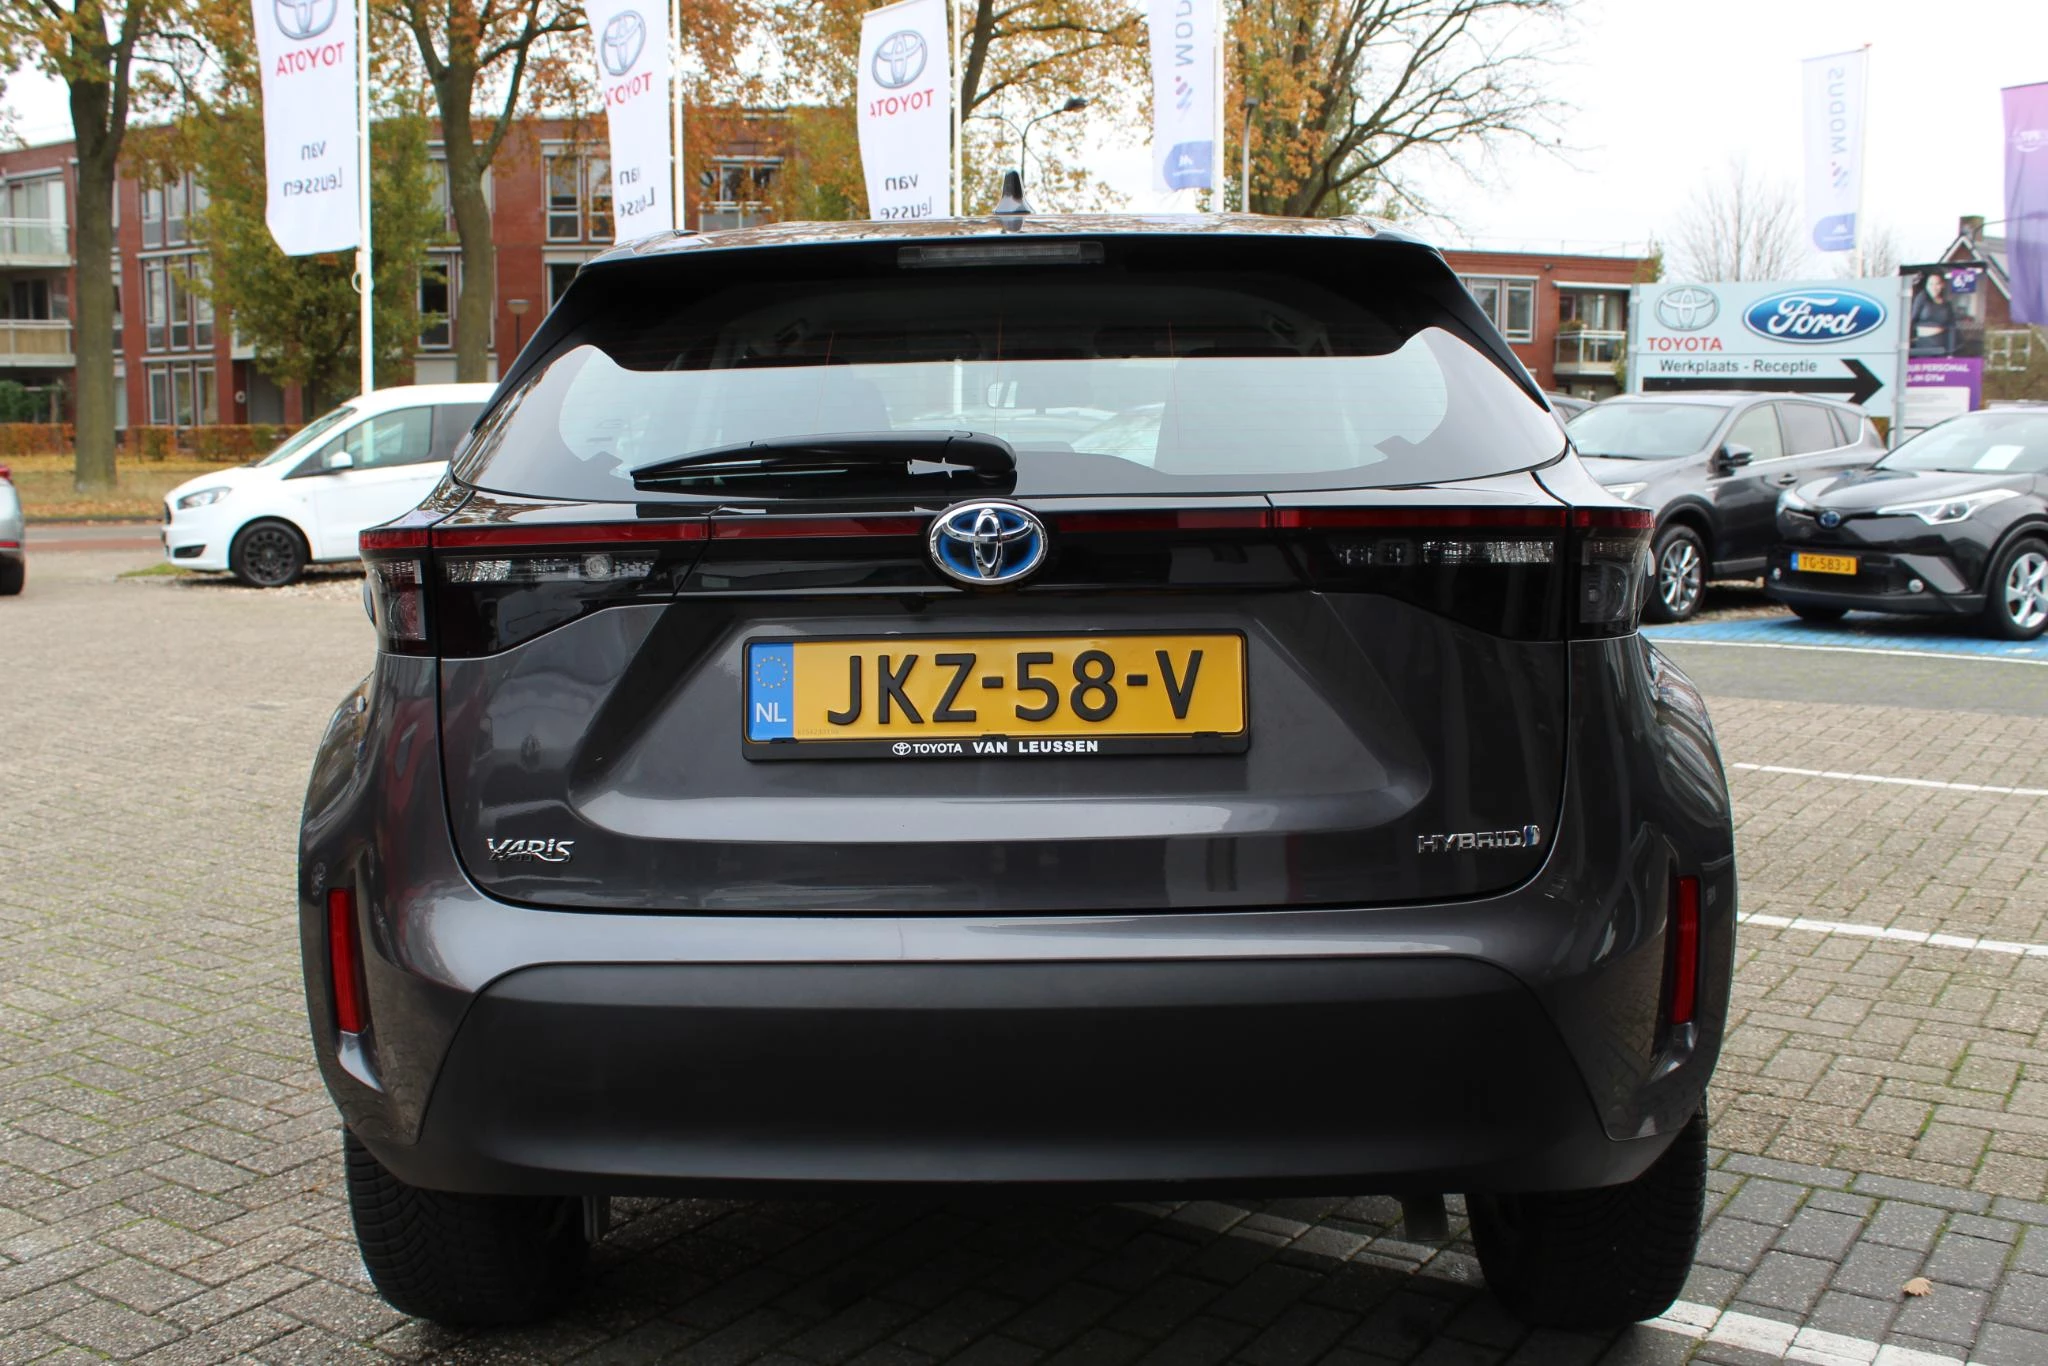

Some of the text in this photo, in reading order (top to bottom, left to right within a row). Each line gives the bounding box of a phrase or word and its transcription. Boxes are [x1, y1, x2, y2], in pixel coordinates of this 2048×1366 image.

[1768, 296, 1858, 334] Ford
[1647, 337, 1723, 352] TOYOTA
[1660, 359, 1740, 374] Werkplaats
[1754, 359, 1818, 374] Receptie
[827, 649, 1204, 726] JKZ-58-V
[755, 702, 787, 723] NL
[913, 740, 1099, 754] TOYOTA VAN LEUSSEN
[1417, 829, 1523, 854] HYBRID
